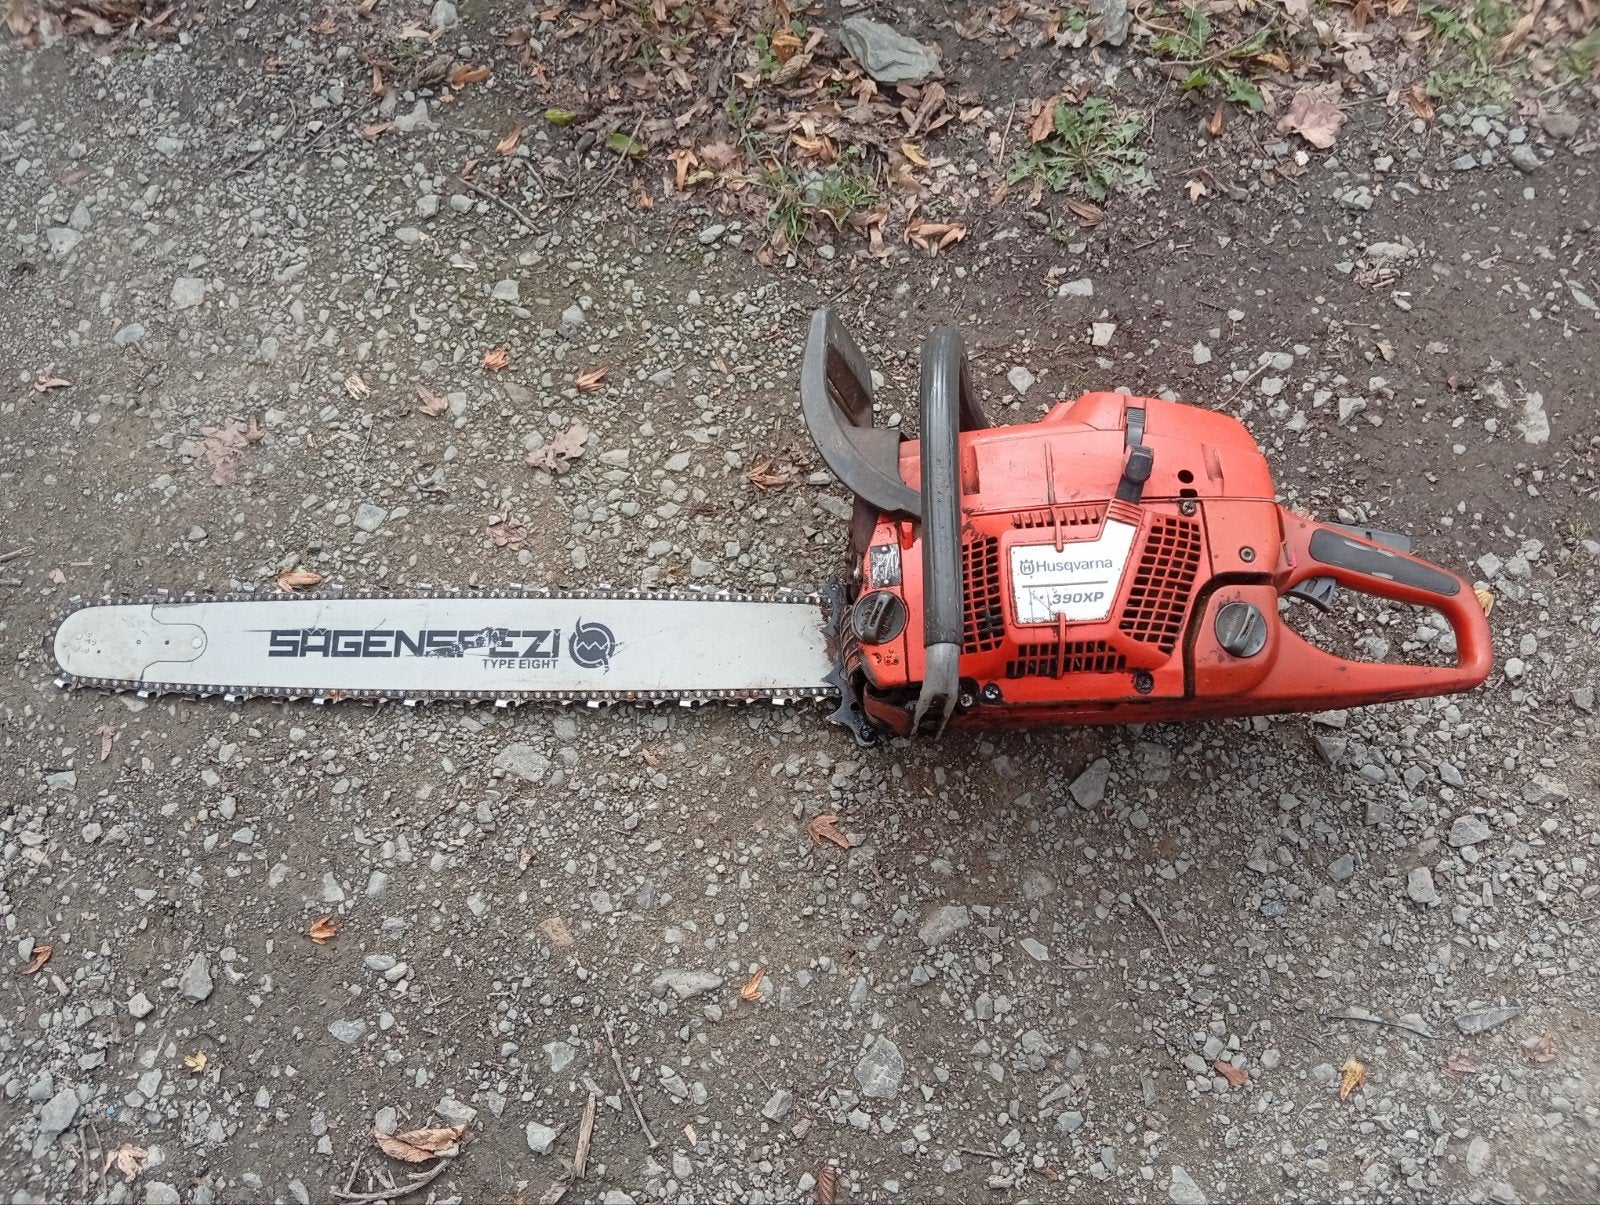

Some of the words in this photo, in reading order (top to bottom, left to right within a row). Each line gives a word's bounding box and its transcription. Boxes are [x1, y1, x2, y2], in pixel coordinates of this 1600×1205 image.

[1036, 558, 1113, 573] Husqvarna
[1052, 591, 1105, 605] 390XP
[482, 659, 516, 670] TYPE
[518, 659, 559, 670] EIGHT
